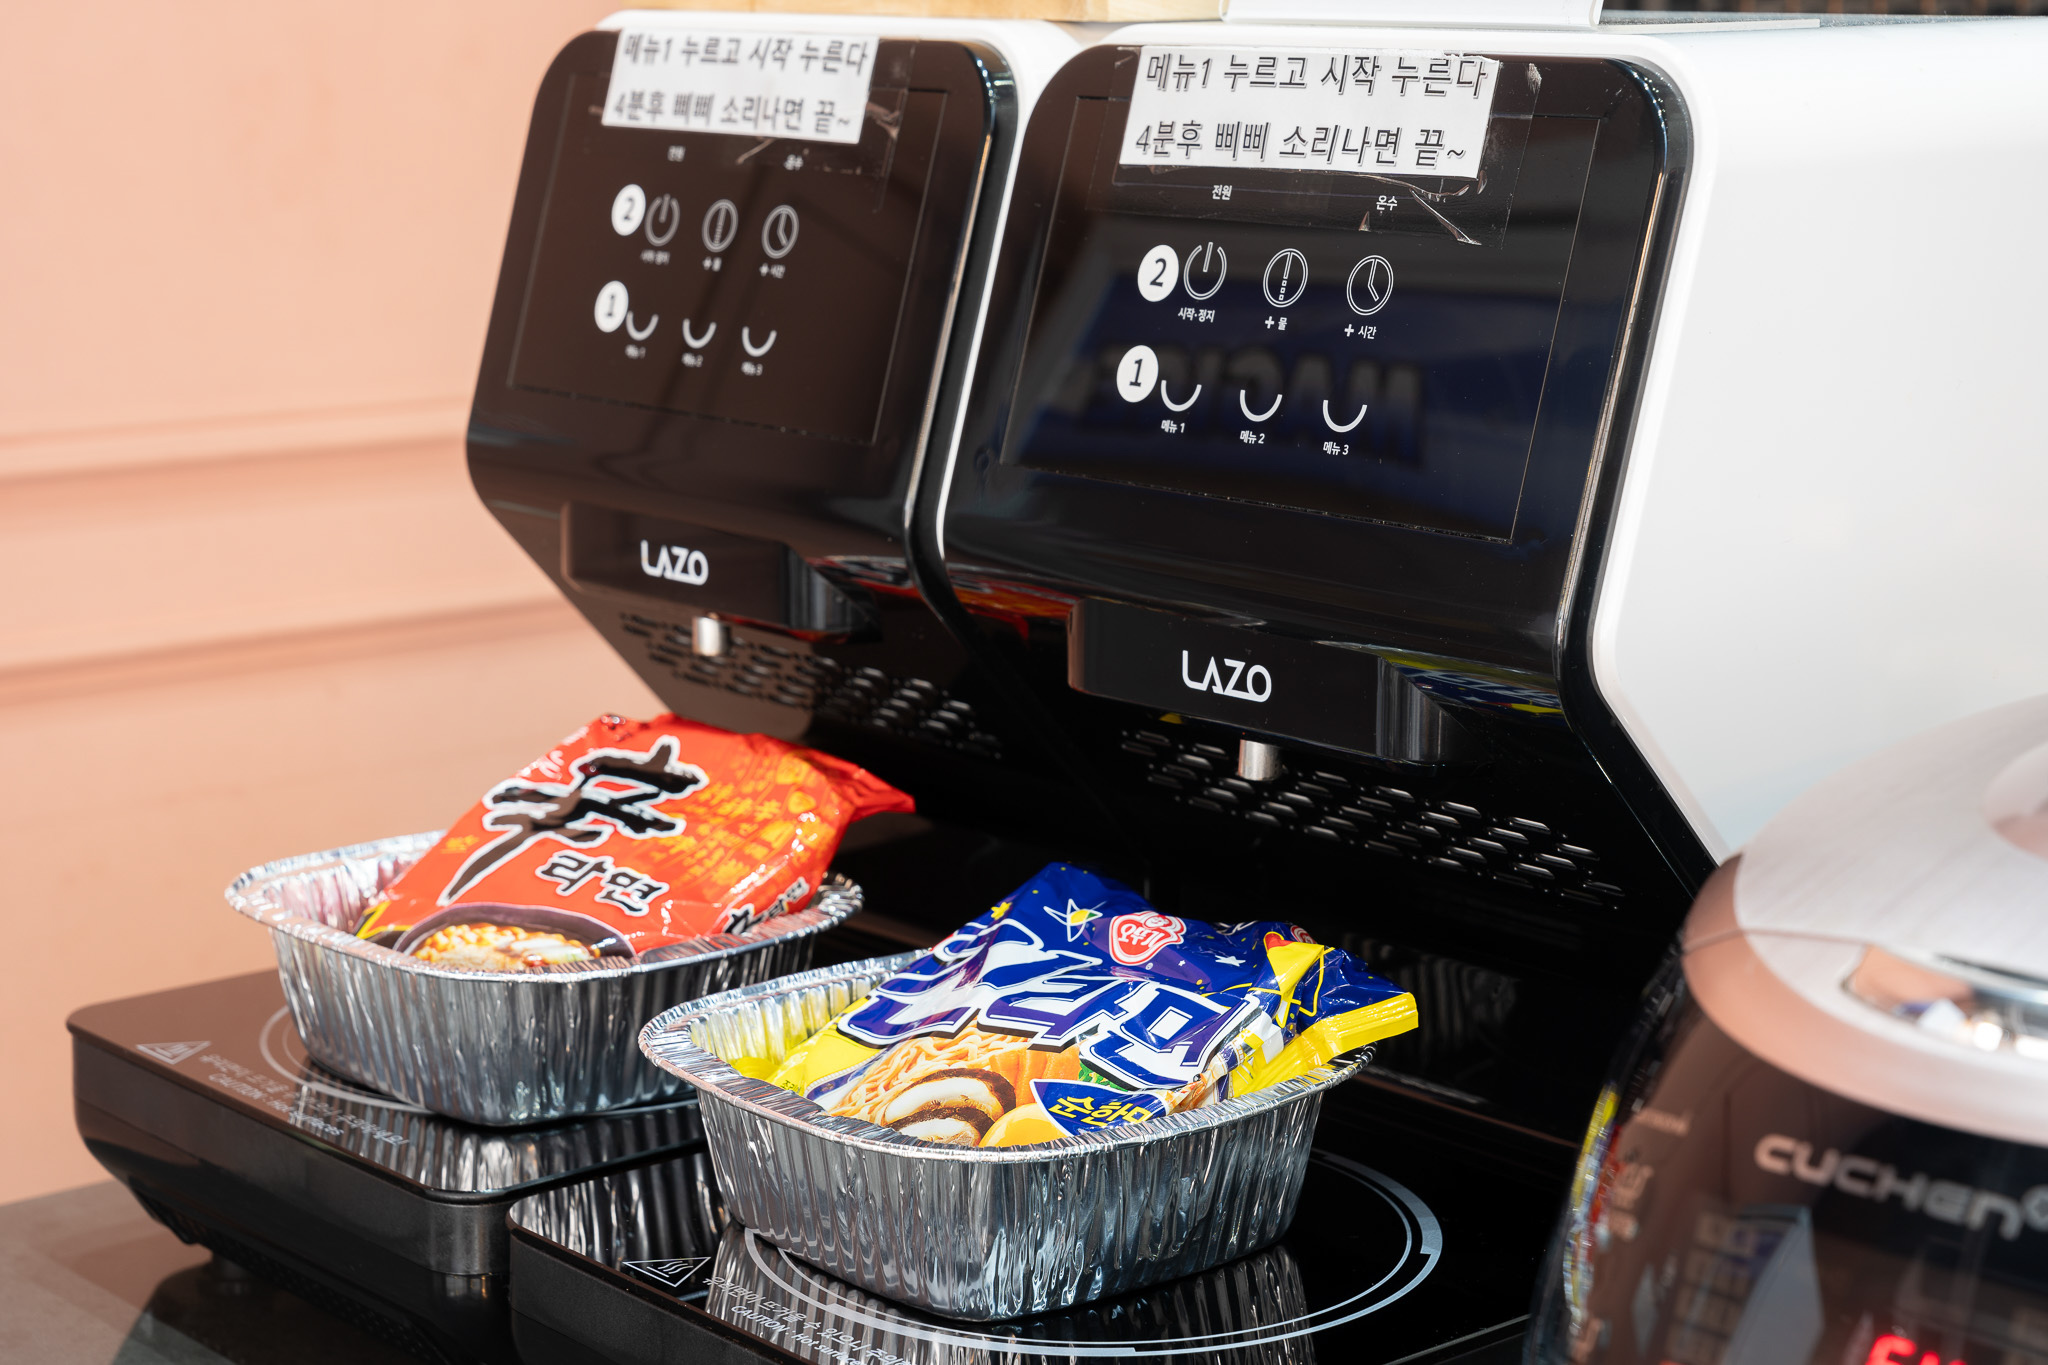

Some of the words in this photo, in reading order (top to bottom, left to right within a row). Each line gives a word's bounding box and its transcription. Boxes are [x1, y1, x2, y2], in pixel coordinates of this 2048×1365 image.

[622, 33, 672, 65] 메뉴1
[681, 36, 741, 67] 누르고
[749, 37, 794, 70] 시작
[799, 39, 869, 75] 누른다
[1146, 52, 1212, 92] 메뉴1
[1224, 55, 1308, 92] 누르고
[1320, 55, 1381, 96] 시작
[1390, 56, 1488, 100] 누른다
[614, 90, 665, 123] 4분후
[673, 92, 715, 126] 삐삐
[721, 95, 803, 132] 소리나면
[814, 99, 851, 135] 끝~
[1135, 119, 1203, 158] 4분후
[1214, 120, 1271, 161] 삐삐
[1278, 124, 1401, 167] 소리나면
[1413, 126, 1467, 168] 끝~
[1211, 183, 1233, 201] 전원
[1376, 195, 1398, 212] 온수
[1150, 257, 1167, 288] 2
[1129, 358, 1144, 388] 1
[640, 539, 709, 586] LAZO
[1182, 650, 1272, 702] LAZO
[535, 850, 671, 918] 라면
[1117, 923, 1165, 948] 오뚜기
[731, 1305, 790, 1332] CAUTION
[791, 1333, 819, 1347] Hot
[817, 1327, 871, 1351] 있으니
